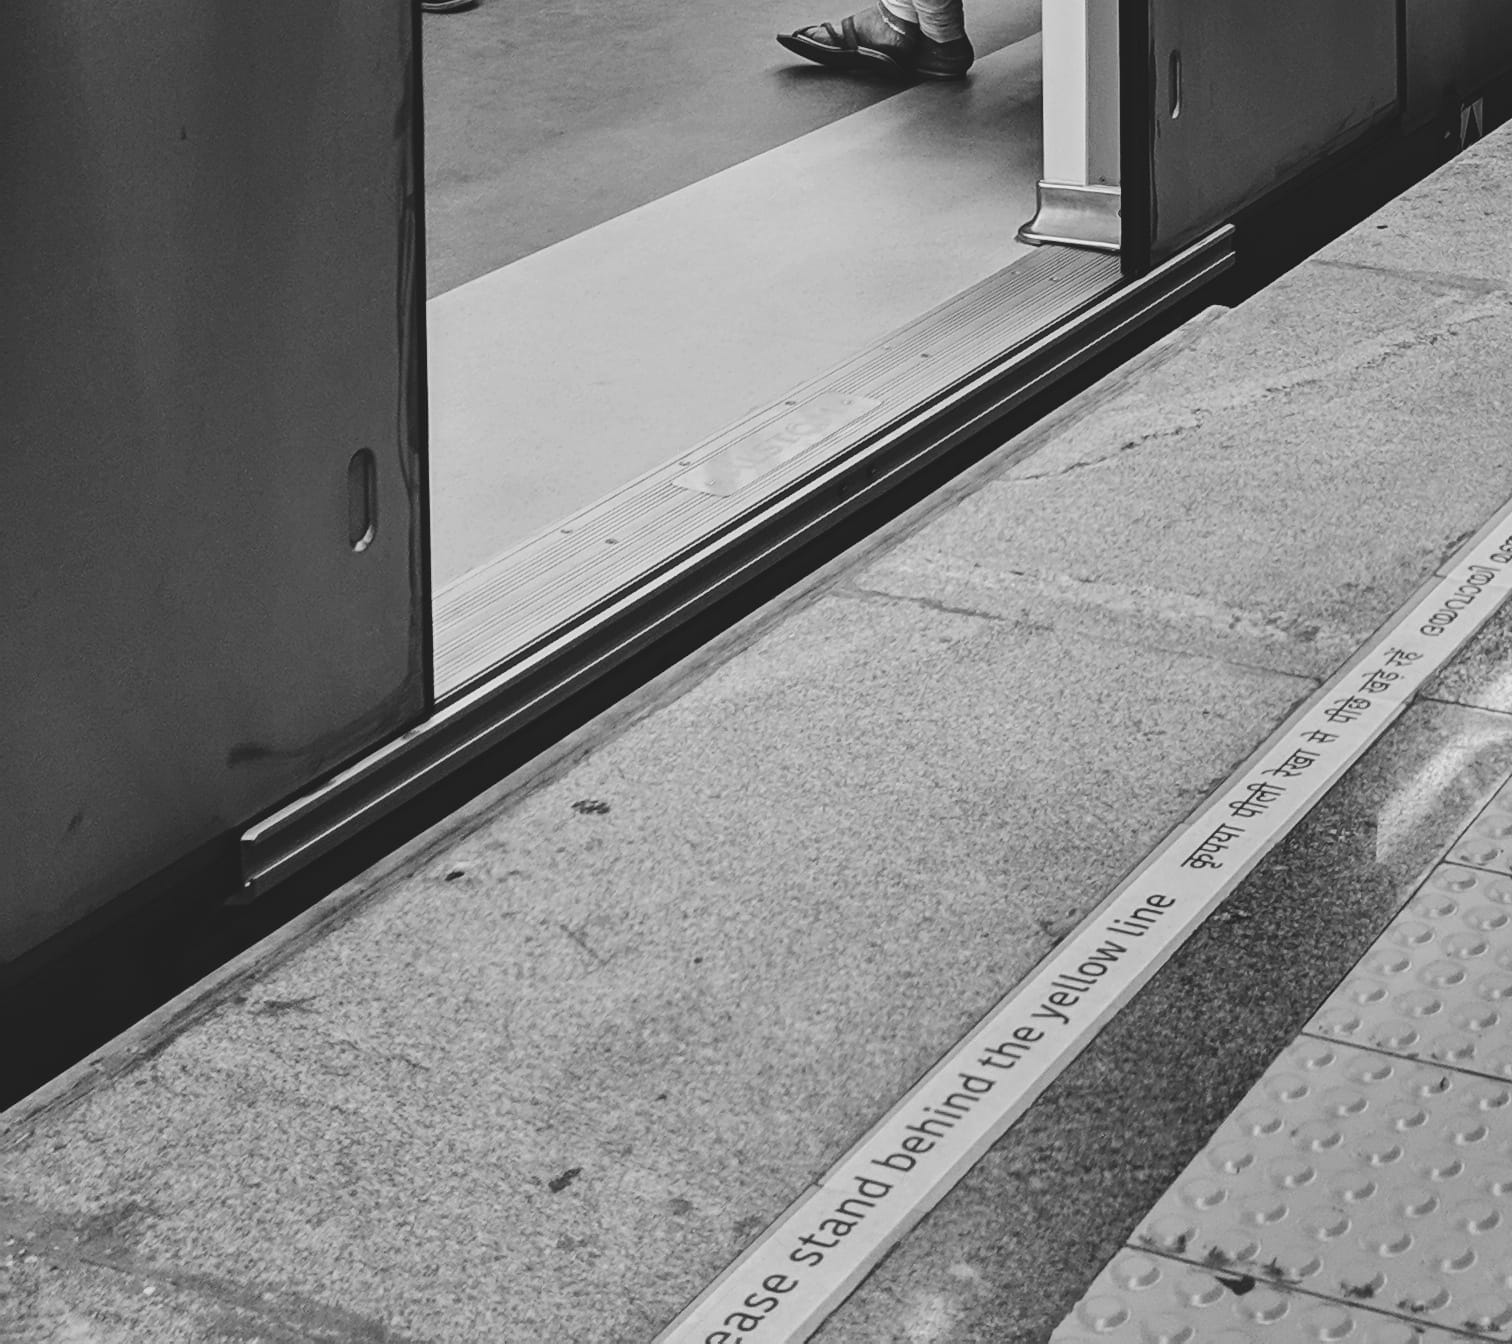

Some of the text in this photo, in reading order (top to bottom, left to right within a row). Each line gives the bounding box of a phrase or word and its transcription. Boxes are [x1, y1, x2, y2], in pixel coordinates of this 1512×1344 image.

[1420, 565, 1501, 637] ദയവായി
[1180, 823, 1246, 869] कृपया
[1229, 782, 1286, 818] पीली
[1261, 748, 1320, 777] रेखा
[1300, 730, 1339, 743] से
[1324, 696, 1371, 723] पीछे
[789, 1176, 894, 1267] stand
[871, 1073, 997, 1172] behind
[977, 1026, 1045, 1069] the
[1031, 940, 1127, 1024] yellow
[1107, 894, 1176, 937] line
